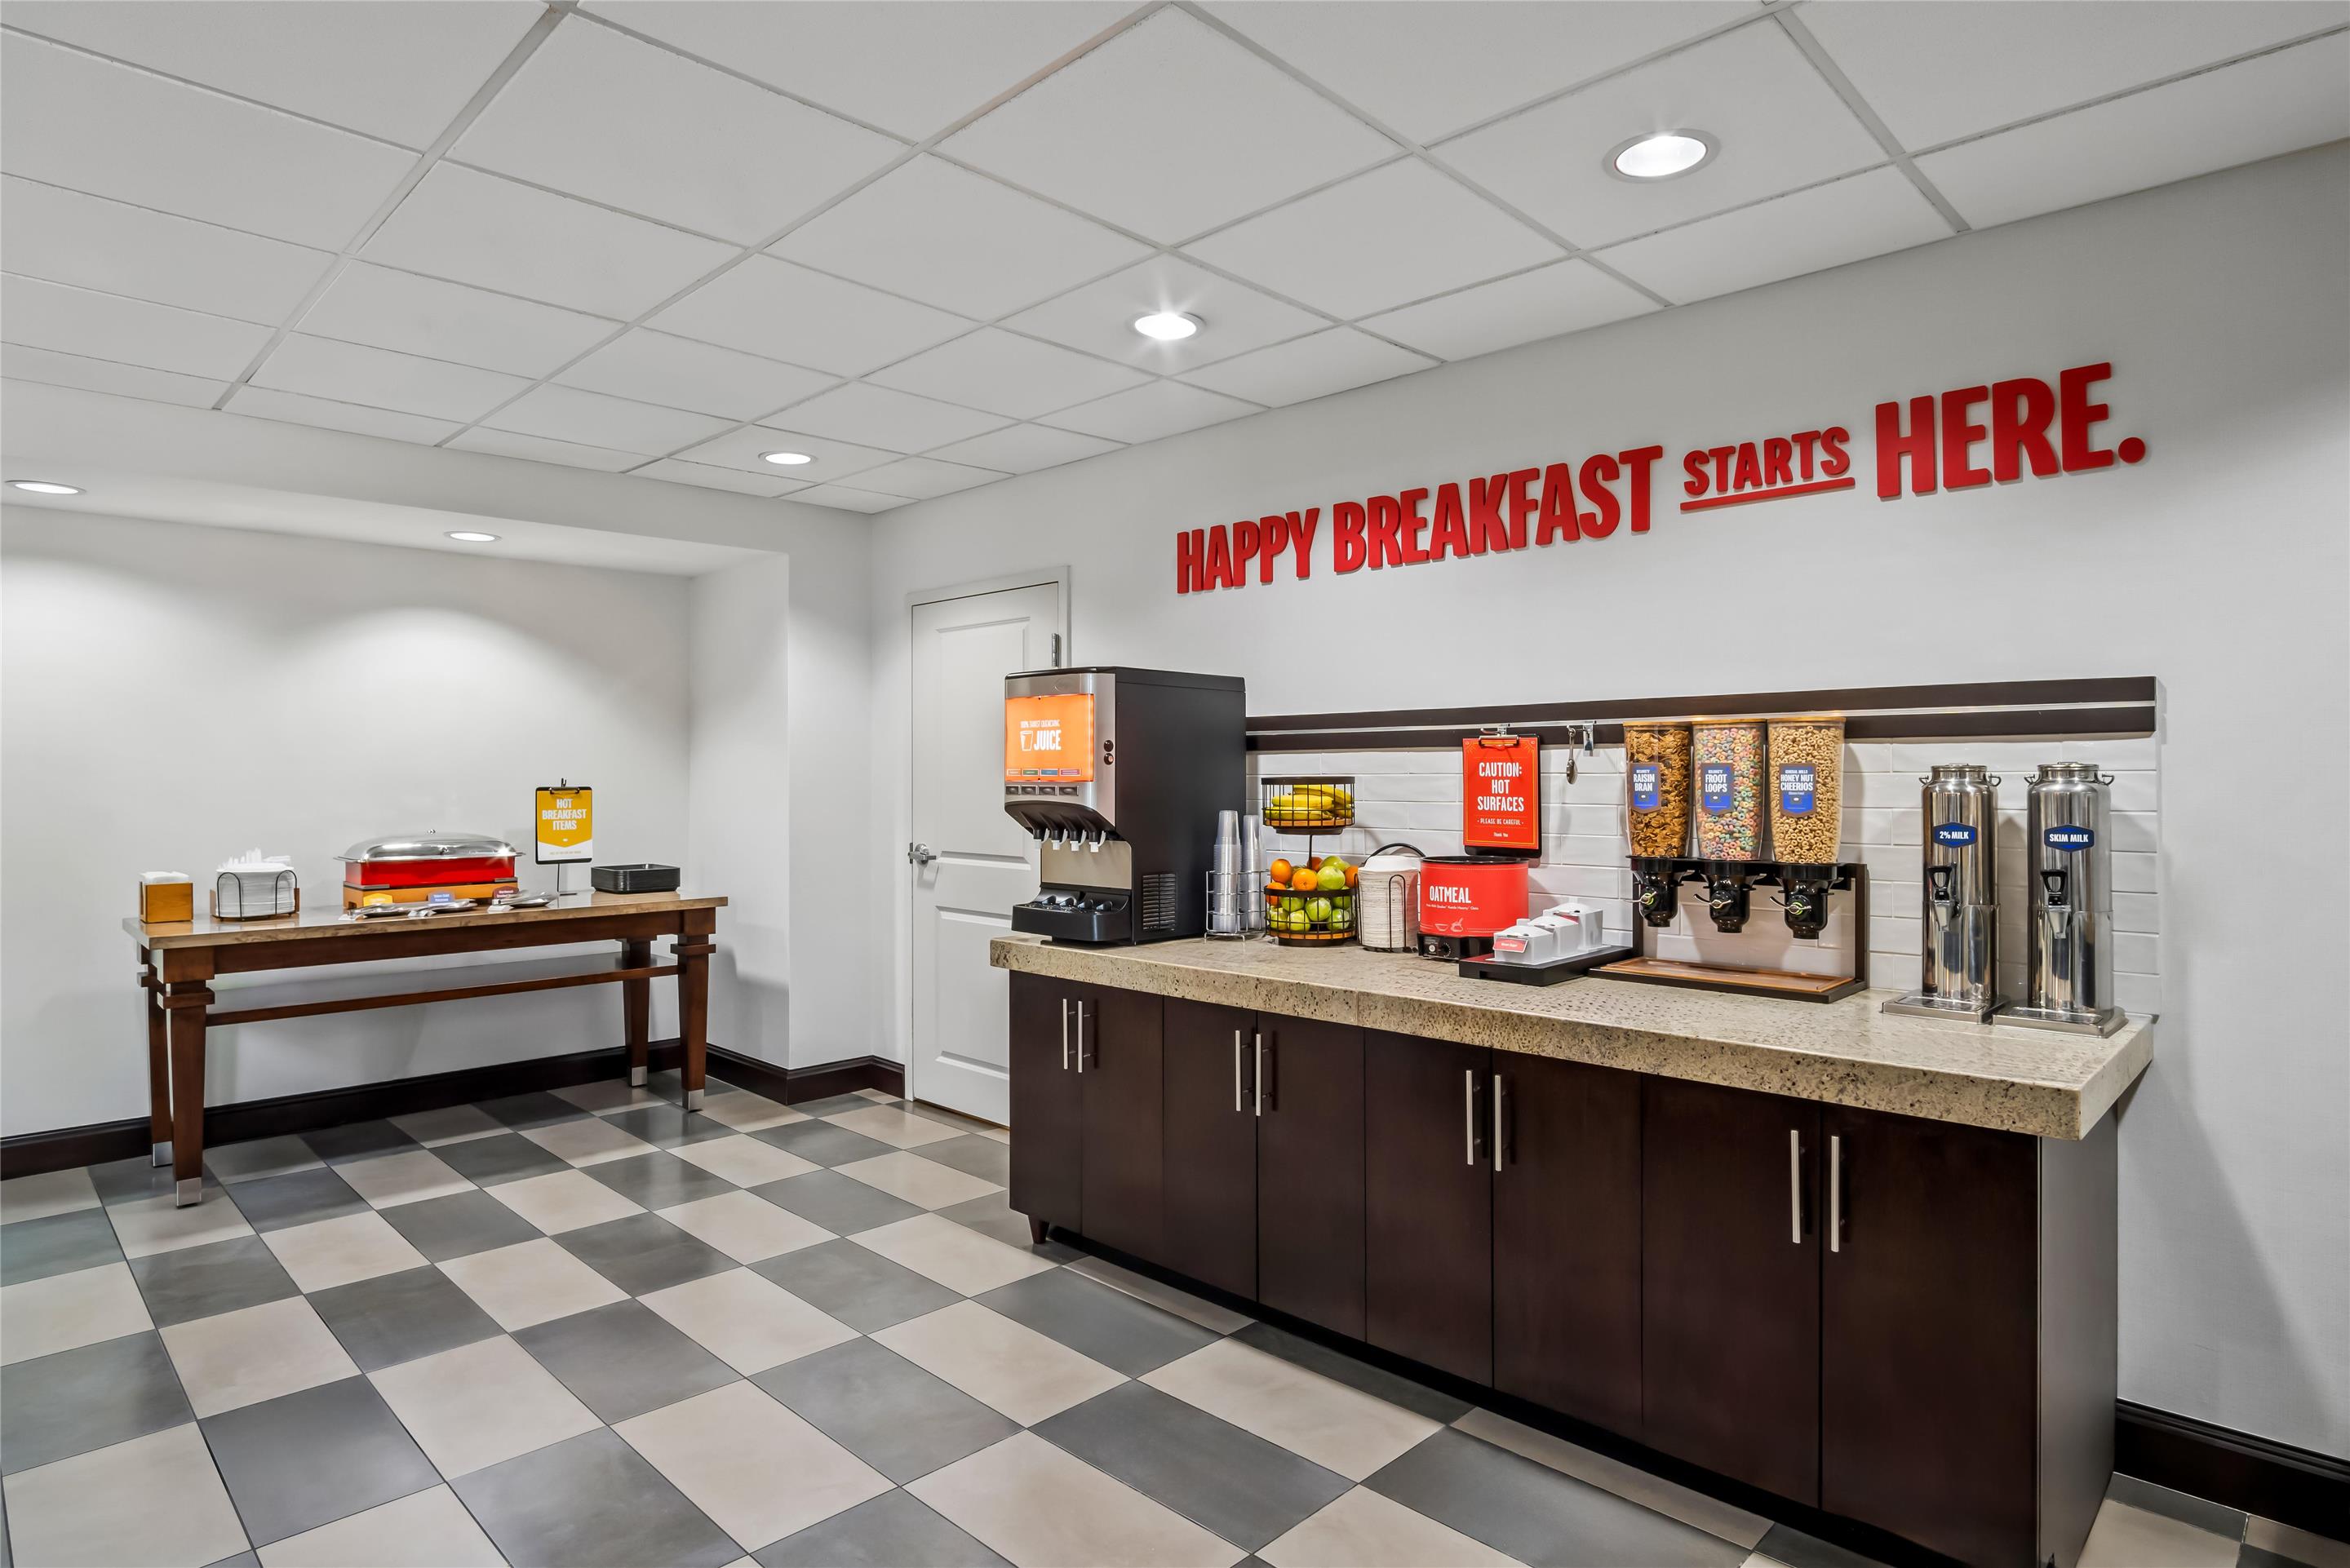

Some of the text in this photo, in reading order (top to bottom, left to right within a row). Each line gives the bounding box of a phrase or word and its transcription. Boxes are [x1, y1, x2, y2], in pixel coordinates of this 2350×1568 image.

[1177, 361, 2146, 594] HAPPY BREAKFAST STARTS HERE.
[1033, 729, 1062, 751] JUICE
[1479, 762, 1523, 777] CAUTION:
[1633, 773, 1655, 782] RAISIN
[1705, 773, 1727, 783] FROOT
[1780, 773, 1814, 782] HONEY NUT
[1491, 779, 1510, 794] HOT
[1634, 782, 1653, 791] BRAN
[1705, 783, 1728, 793] LOOPS
[1780, 782, 1814, 791] CHEERIOS
[556, 799, 573, 808] HOT
[1477, 796, 1524, 812] SURFACES
[542, 808, 587, 820] BREAKFAST
[552, 820, 578, 831] ITEMS
[1939, 831, 1969, 839] 2% MILK
[2049, 834, 2089, 843] SKIM MILK
[1430, 885, 1472, 904] OATMEAL
